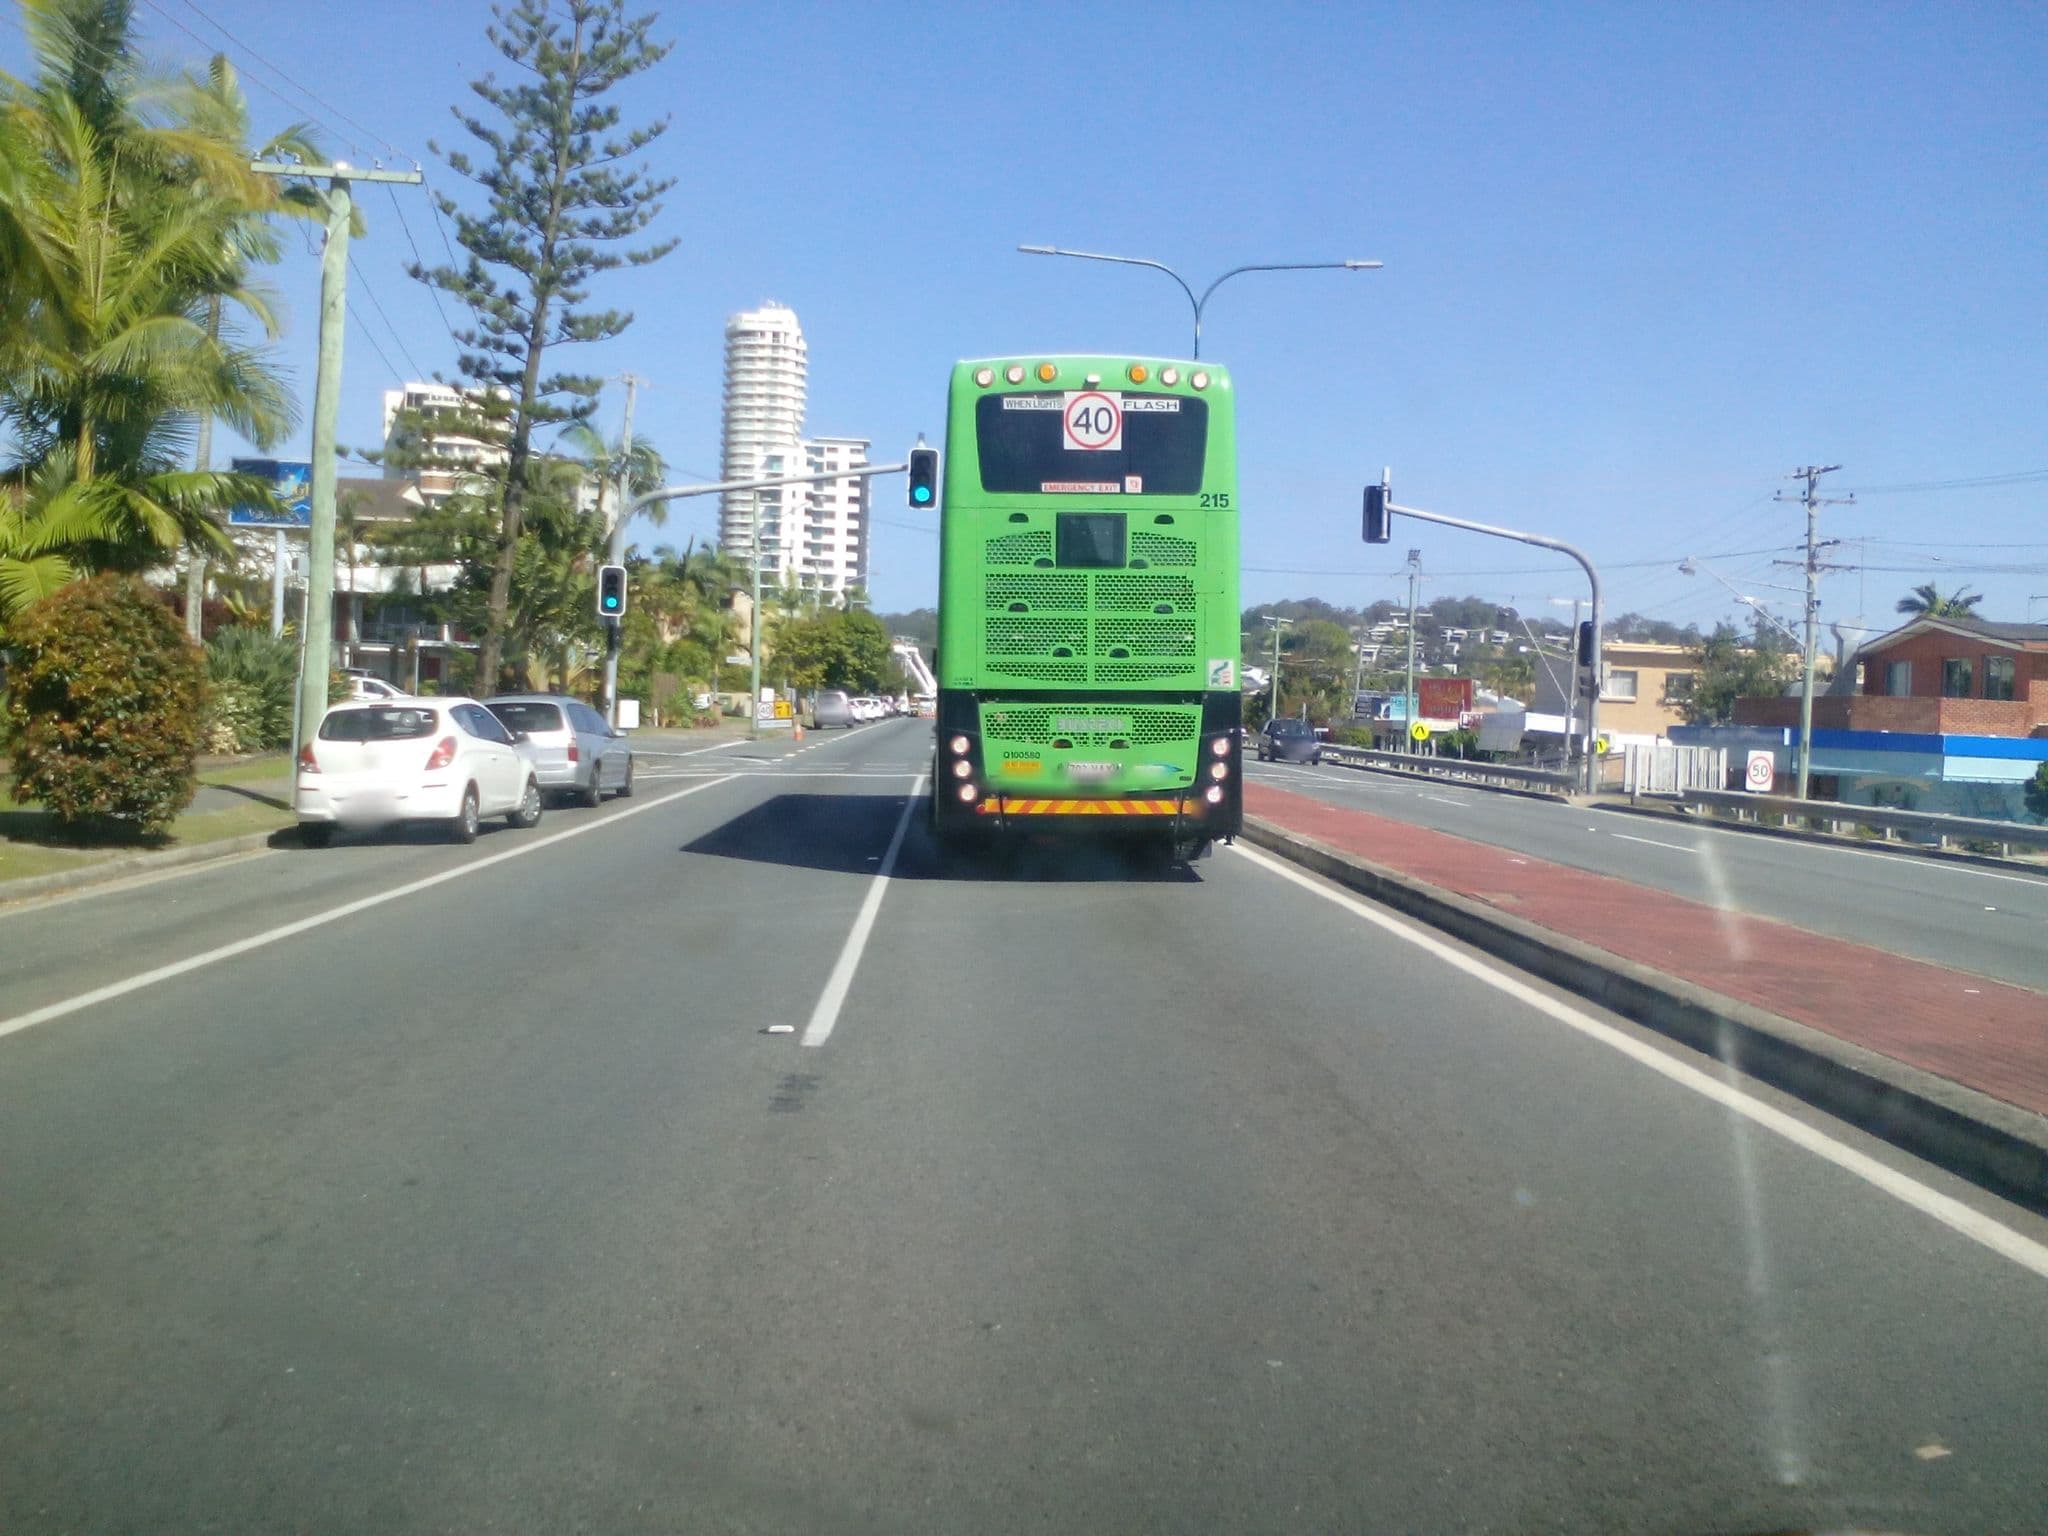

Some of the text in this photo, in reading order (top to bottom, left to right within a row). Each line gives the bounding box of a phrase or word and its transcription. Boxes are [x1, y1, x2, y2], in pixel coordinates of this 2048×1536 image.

[1005, 399, 1064, 409] WHEN LIGHTS
[1123, 400, 1178, 410] FLASH
[1072, 407, 1113, 435] 40
[1044, 483, 1117, 491] EMERGENCY EXIT
[1200, 494, 1229, 507] 215
[1752, 764, 1768, 777] 50
